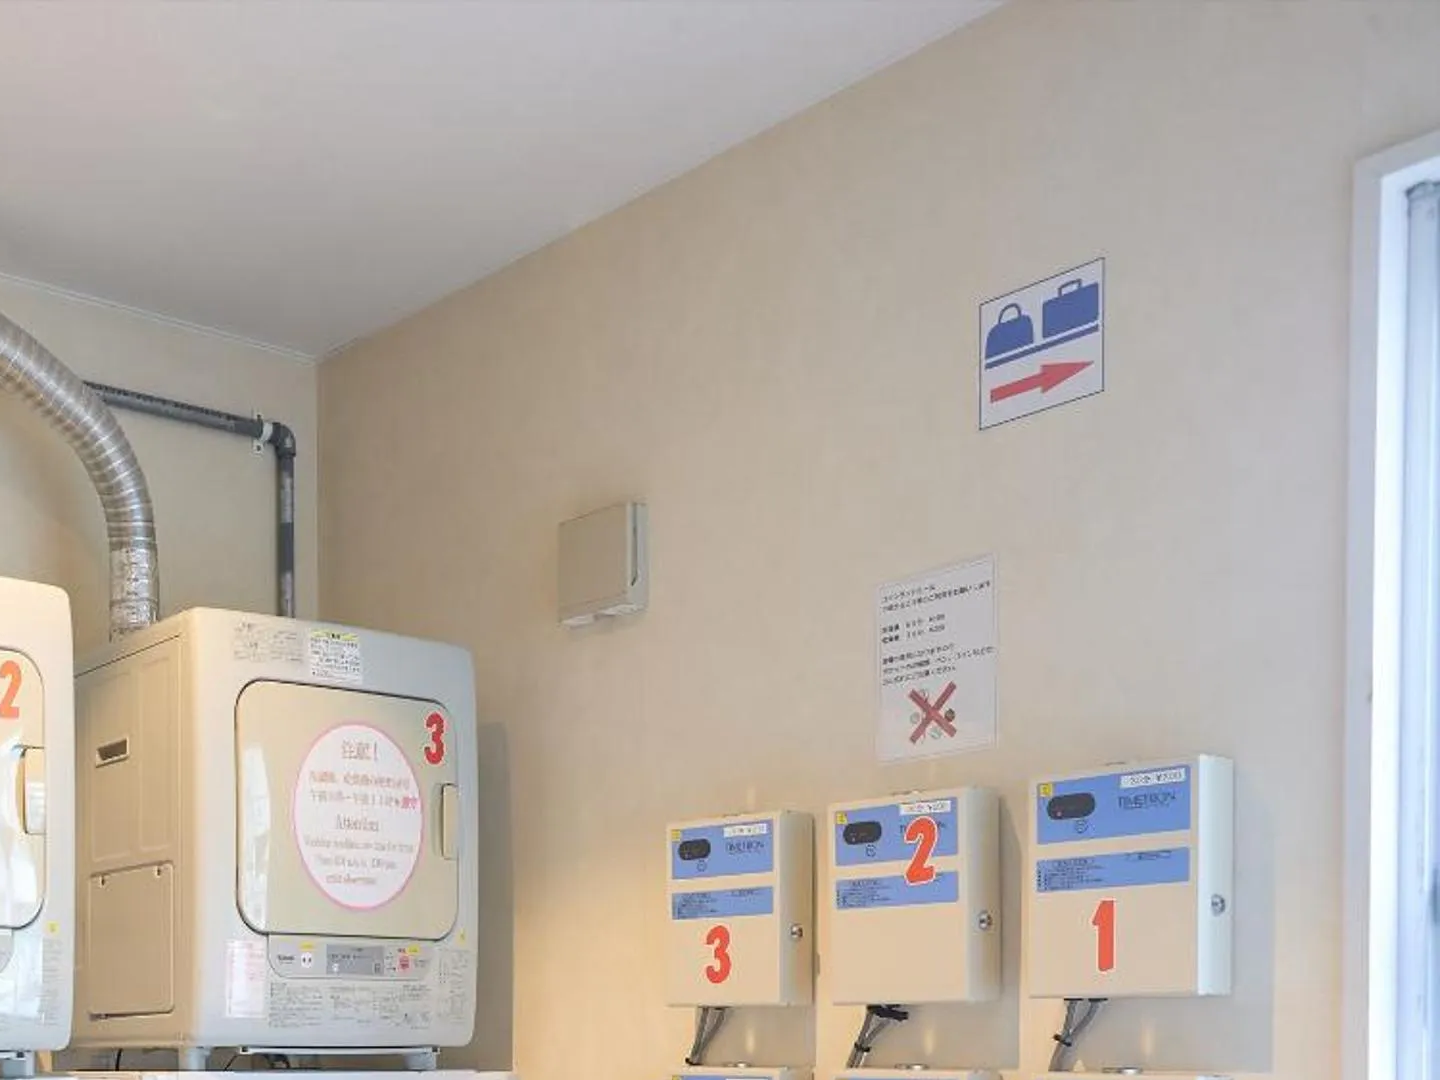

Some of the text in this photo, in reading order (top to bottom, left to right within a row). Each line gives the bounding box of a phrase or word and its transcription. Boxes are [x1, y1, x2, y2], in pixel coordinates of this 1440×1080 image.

[424, 712, 445, 765] 3
[905, 818, 936, 884] 2
[705, 925, 732, 984] 3
[1093, 900, 1116, 971] 1
